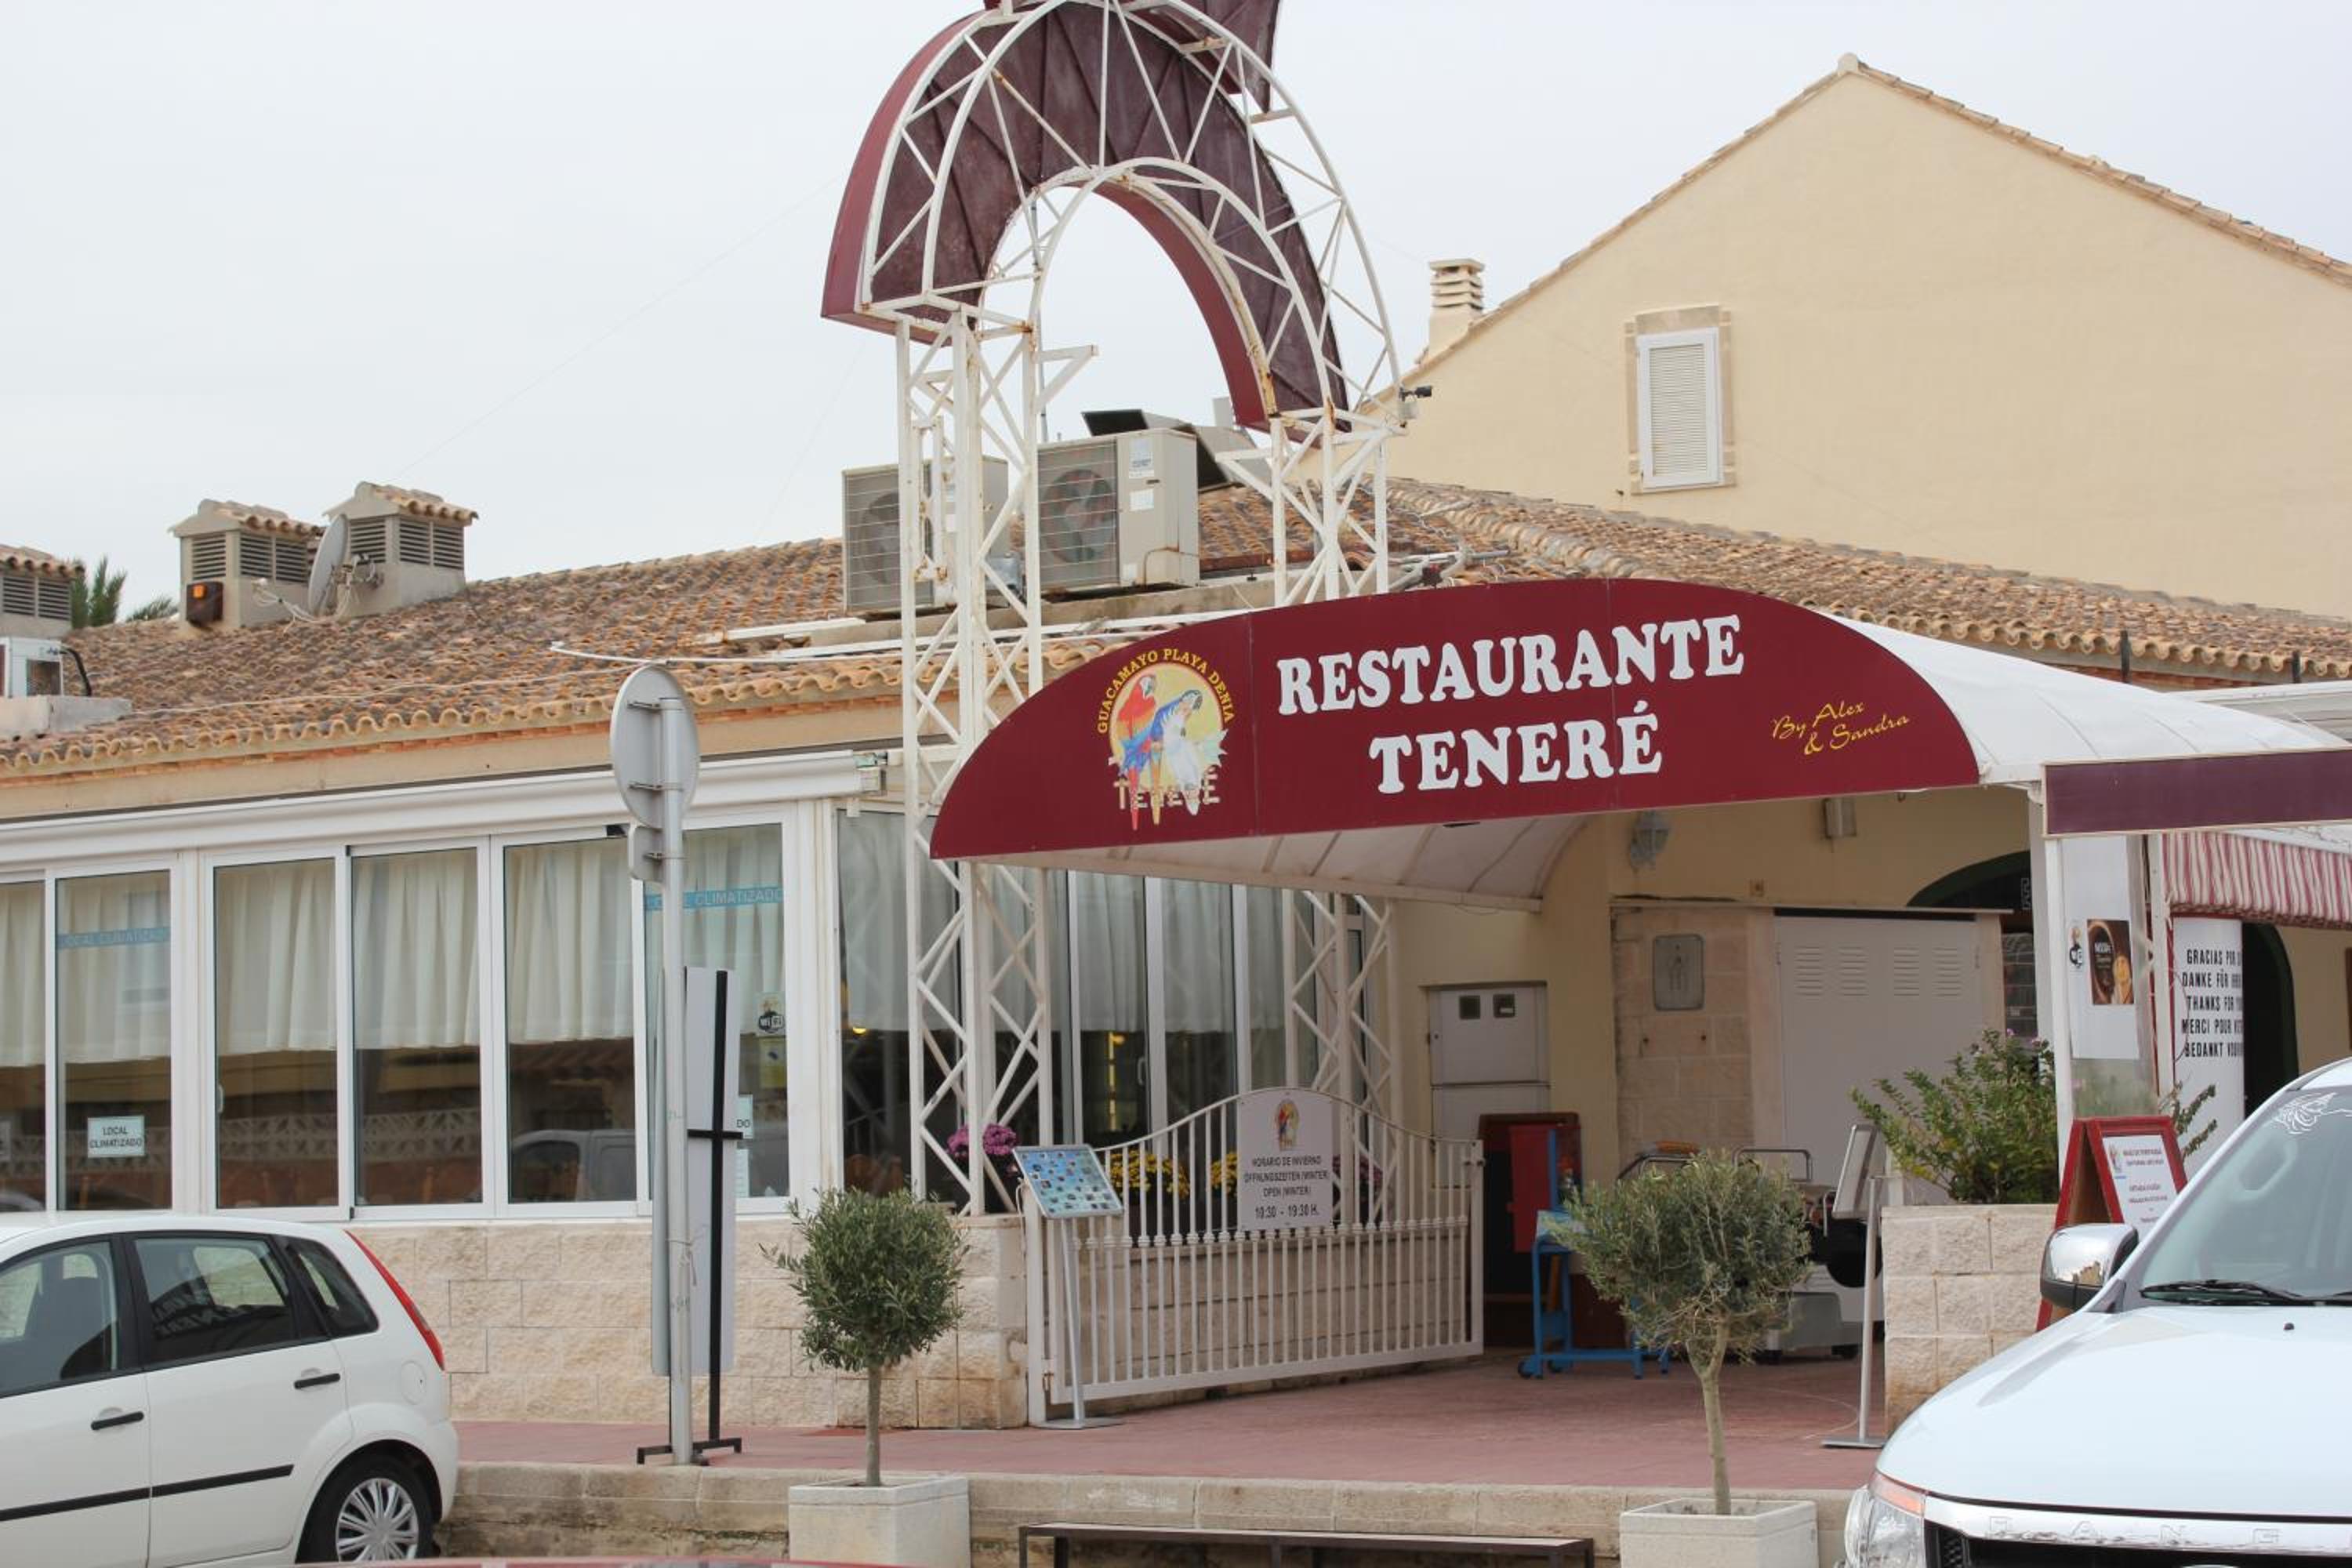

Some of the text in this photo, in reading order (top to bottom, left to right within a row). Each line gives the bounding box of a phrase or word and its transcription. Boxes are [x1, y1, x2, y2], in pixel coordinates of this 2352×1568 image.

[1276, 614, 1744, 716] RESTAURANTE
[1098, 648, 1236, 735] GUACAMAYO PLAYA DENIA
[1771, 700, 1864, 740] By Alex
[1829, 713, 1910, 750] Sandra
[1369, 700, 1662, 794] TENERÉ
[2187, 949, 2223, 965] GRACIAS
[2183, 971, 2212, 988] DANKE
[2187, 996, 2220, 1011] THANKS
[2182, 1018, 2210, 1034] MERCI
[2185, 1042, 2223, 1058] BEDANKT
[1989, 1515, 2352, 1546] RANG
